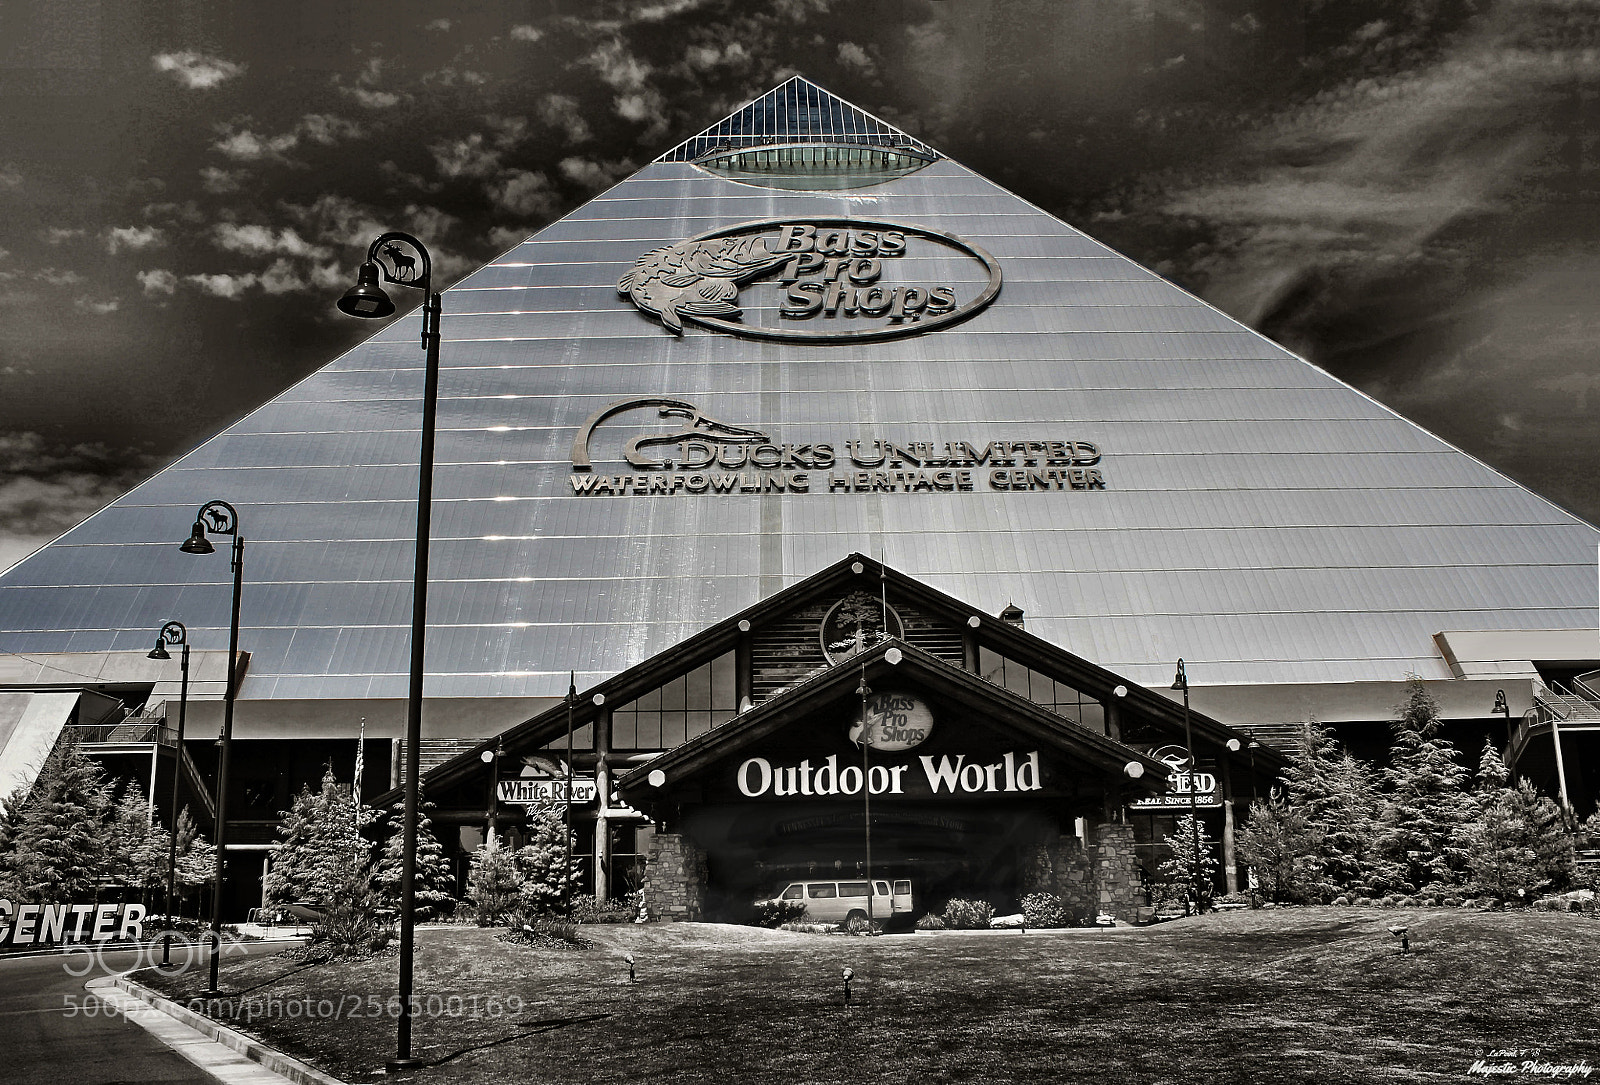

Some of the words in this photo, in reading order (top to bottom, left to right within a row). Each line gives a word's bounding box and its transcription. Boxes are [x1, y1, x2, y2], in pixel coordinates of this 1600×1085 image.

[770, 224, 907, 257] Bass
[777, 252, 882, 285] Pro
[780, 281, 956, 321] Shops
[677, 439, 836, 469] DUCKS
[845, 438, 1102, 468] UNLIMITED
[570, 472, 809, 497] WATERFOWLING
[829, 470, 973, 493] HERITAGE
[990, 469, 1105, 491] CENTER
[878, 694, 914, 711] Bass
[881, 710, 907, 727] Pro
[881, 726, 925, 745] Shops
[737, 753, 909, 798] Outdoor
[918, 750, 1043, 794] World
[500, 781, 548, 801] White
[552, 781, 594, 801] River
[1165, 796, 1192, 806] SINCE
